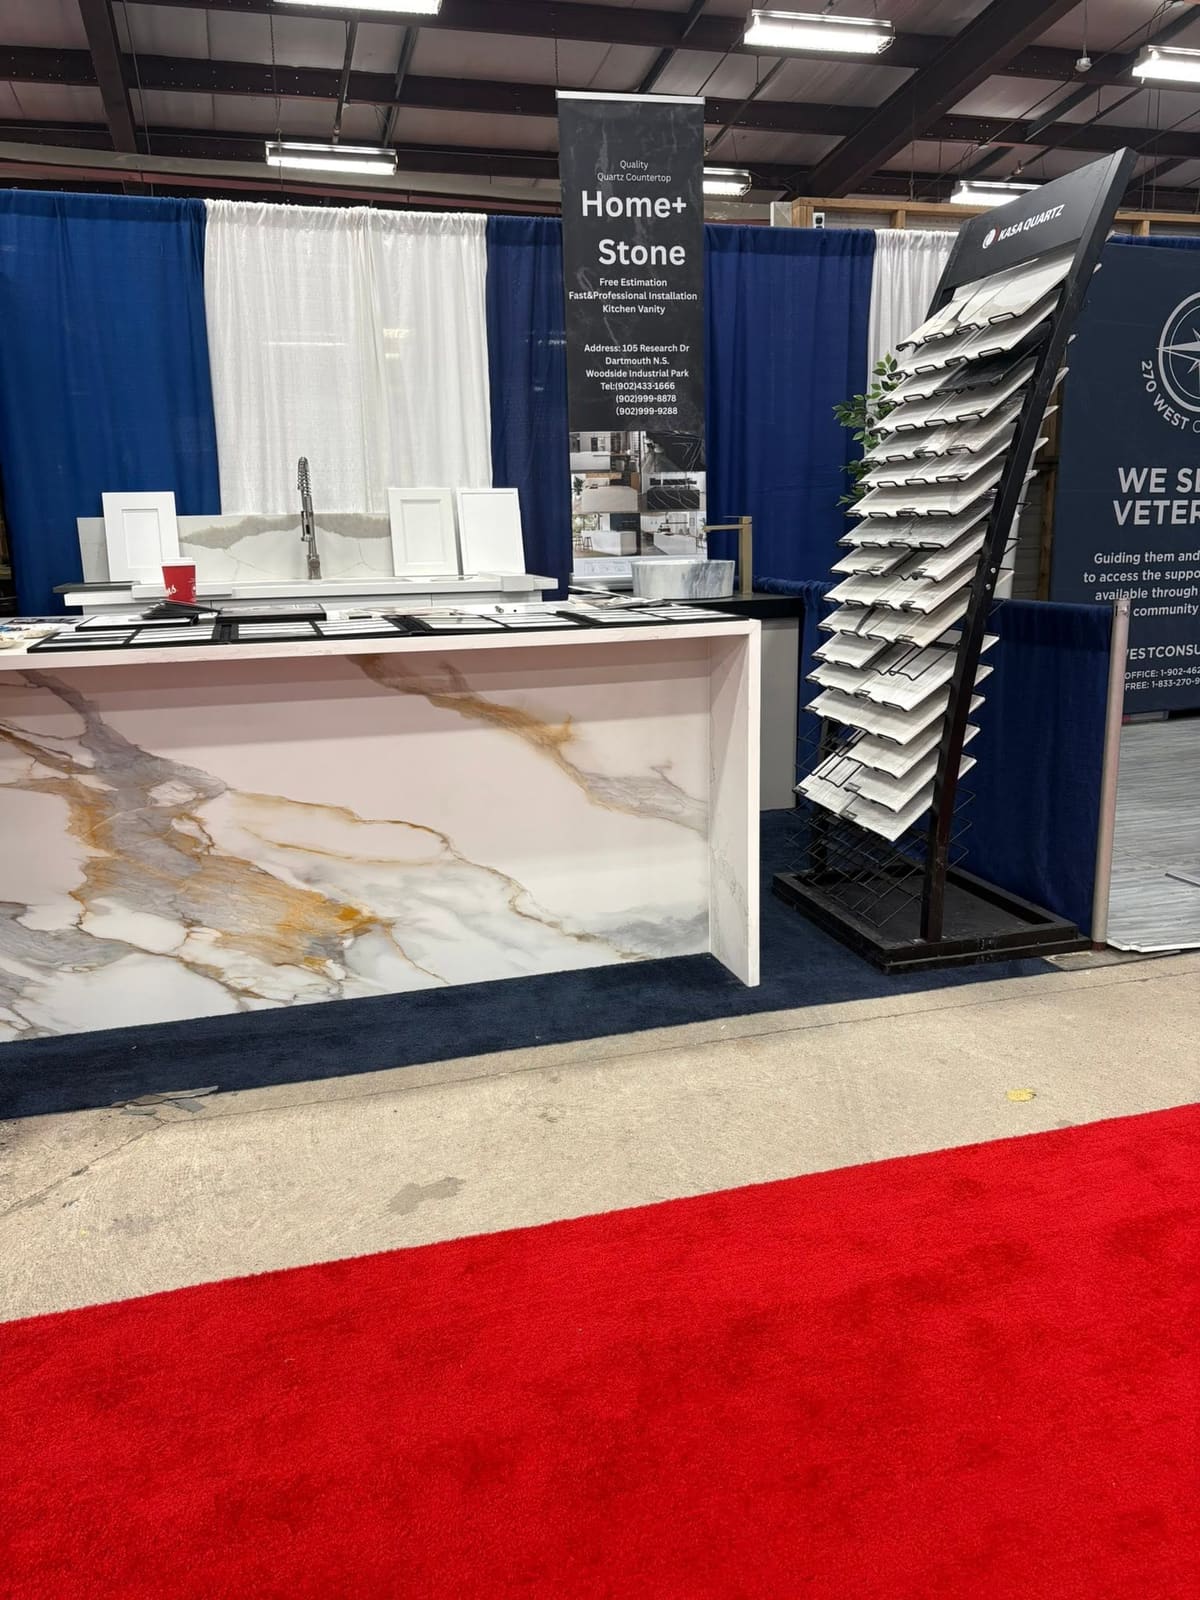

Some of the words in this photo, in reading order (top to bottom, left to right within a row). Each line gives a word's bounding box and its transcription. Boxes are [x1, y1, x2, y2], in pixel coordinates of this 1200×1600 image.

[620, 160, 649, 171] Quality
[597, 173, 624, 182] Quartz
[626, 173, 672, 184] Countertop
[581, 190, 687, 219] Home+
[998, 221, 1024, 242] KASA
[1023, 204, 1065, 231] QUARTZ
[598, 239, 686, 266] Stone
[599, 277, 619, 287] Free
[621, 278, 668, 287] Estimation
[568, 291, 647, 301] Fast&Professional
[649, 292, 698, 301] Installation
[602, 305, 636, 314] Kitchen
[638, 305, 666, 315] Vanity
[584, 344, 621, 353] Address:
[622, 344, 639, 353] 105
[640, 344, 678, 353] Research
[679, 344, 690, 353] Dr
[605, 357, 652, 365] Dartmouth
[653, 357, 670, 365] N.S.
[585, 369, 628, 378] Woodside
[629, 369, 669, 378] Industrial
[671, 369, 690, 378] Park
[1141, 359, 1157, 393] 270
[1153, 393, 1190, 431] WEST
[616, 407, 678, 416] (902)999-9288
[1118, 467, 1168, 494] WE
[1094, 552, 1141, 565] Guiding
[1144, 551, 1175, 563] them
[1178, 550, 1200, 562] and
[1083, 572, 1097, 583] to
[1099, 572, 1139, 583] access
[1142, 569, 1162, 581] the
[1094, 588, 1149, 601] available
[1151, 586, 1199, 599] through
[1133, 603, 1199, 617] community
[1124, 669, 1159, 680] OFFICE:
[1125, 681, 1150, 691] FREE:
